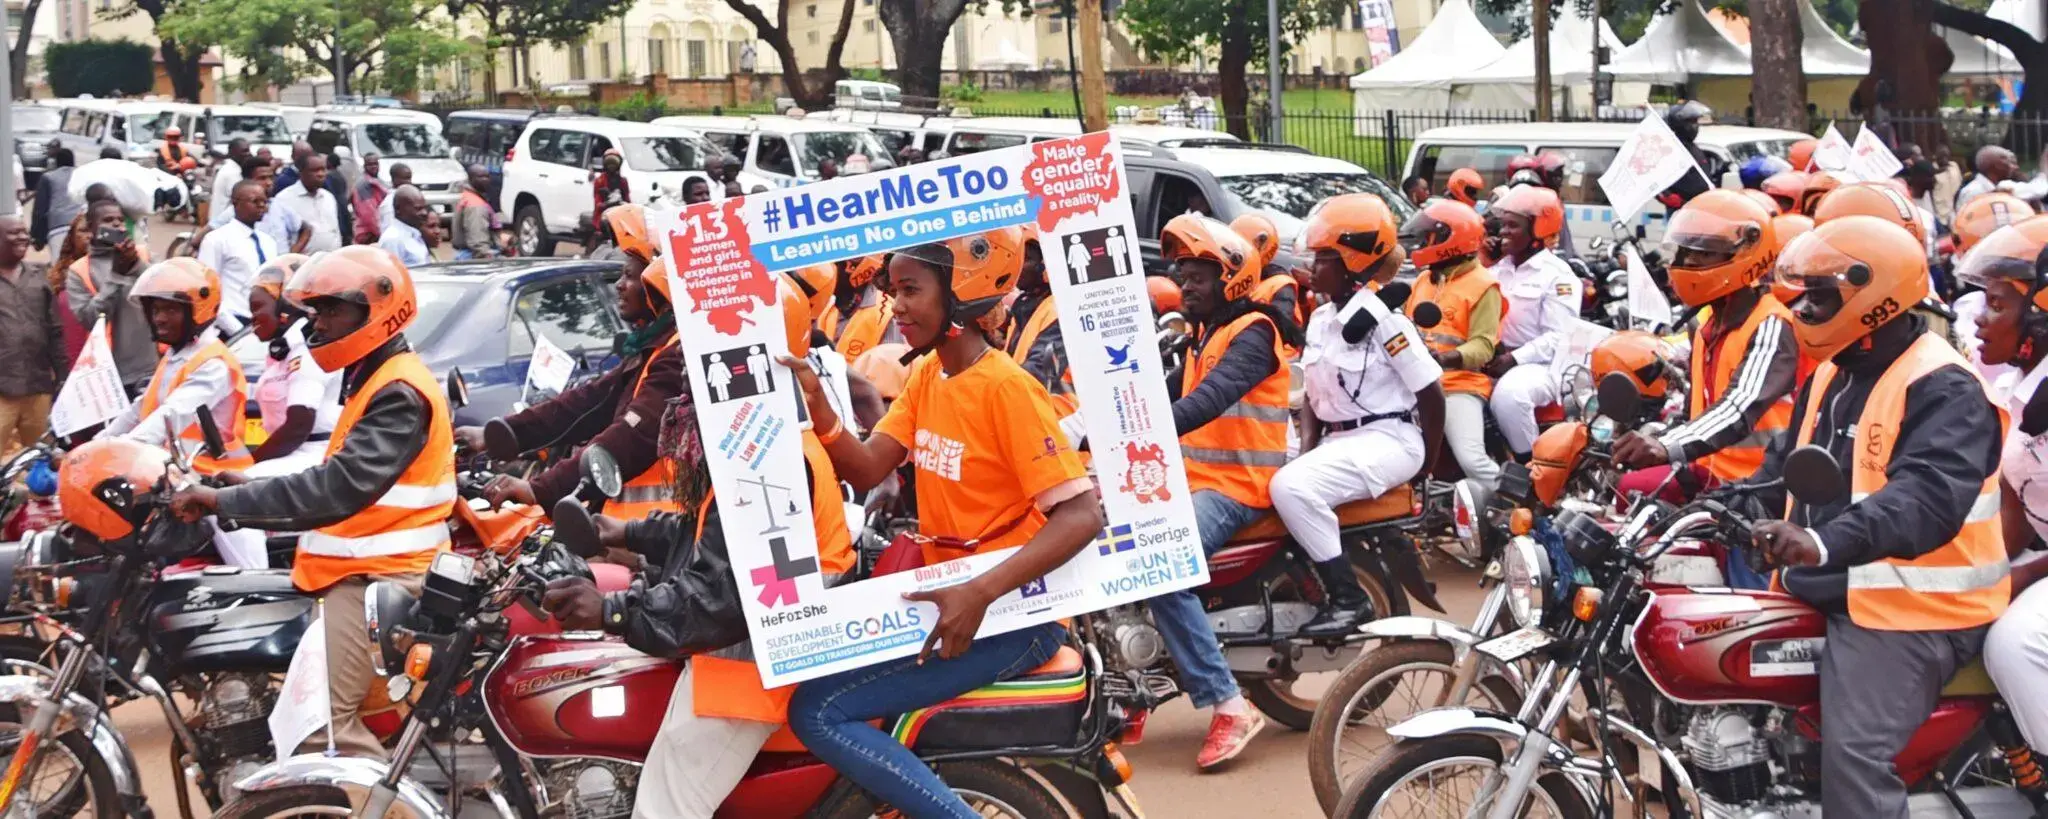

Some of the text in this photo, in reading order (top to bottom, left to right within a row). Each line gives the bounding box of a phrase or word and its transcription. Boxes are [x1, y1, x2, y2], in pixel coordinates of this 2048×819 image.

[1042, 143, 1087, 162] Make
[1031, 157, 1104, 185] gender
[1043, 172, 1112, 197] equality
[763, 164, 1008, 233] #HearMeToo
[1049, 193, 1100, 211] a reality
[704, 230, 715, 240] in
[770, 200, 1027, 262] Leaving No One Behind
[690, 240, 736, 254] women
[689, 249, 741, 266] and girls
[684, 260, 751, 278] experience
[688, 270, 752, 289] violence in
[707, 284, 736, 296] their
[700, 294, 747, 309] lifetime
[382, 300, 413, 337] 2102
[1861, 297, 1899, 328] 993
[1080, 314, 1095, 332] 16
[740, 442, 757, 461] Law
[1135, 516, 1167, 529] Sweden
[1138, 526, 1190, 547] Sverige
[1140, 551, 1168, 569] UN
[915, 563, 942, 582] Only
[945, 559, 971, 576] 30%
[1101, 567, 1172, 596] WOMEN
[761, 604, 828, 628] HeForShe
[845, 607, 921, 640] GOALS
[766, 623, 843, 650] SUSTAINABLE
[769, 635, 845, 661] DEVELOPMENT
[814, 653, 825, 663] TO
